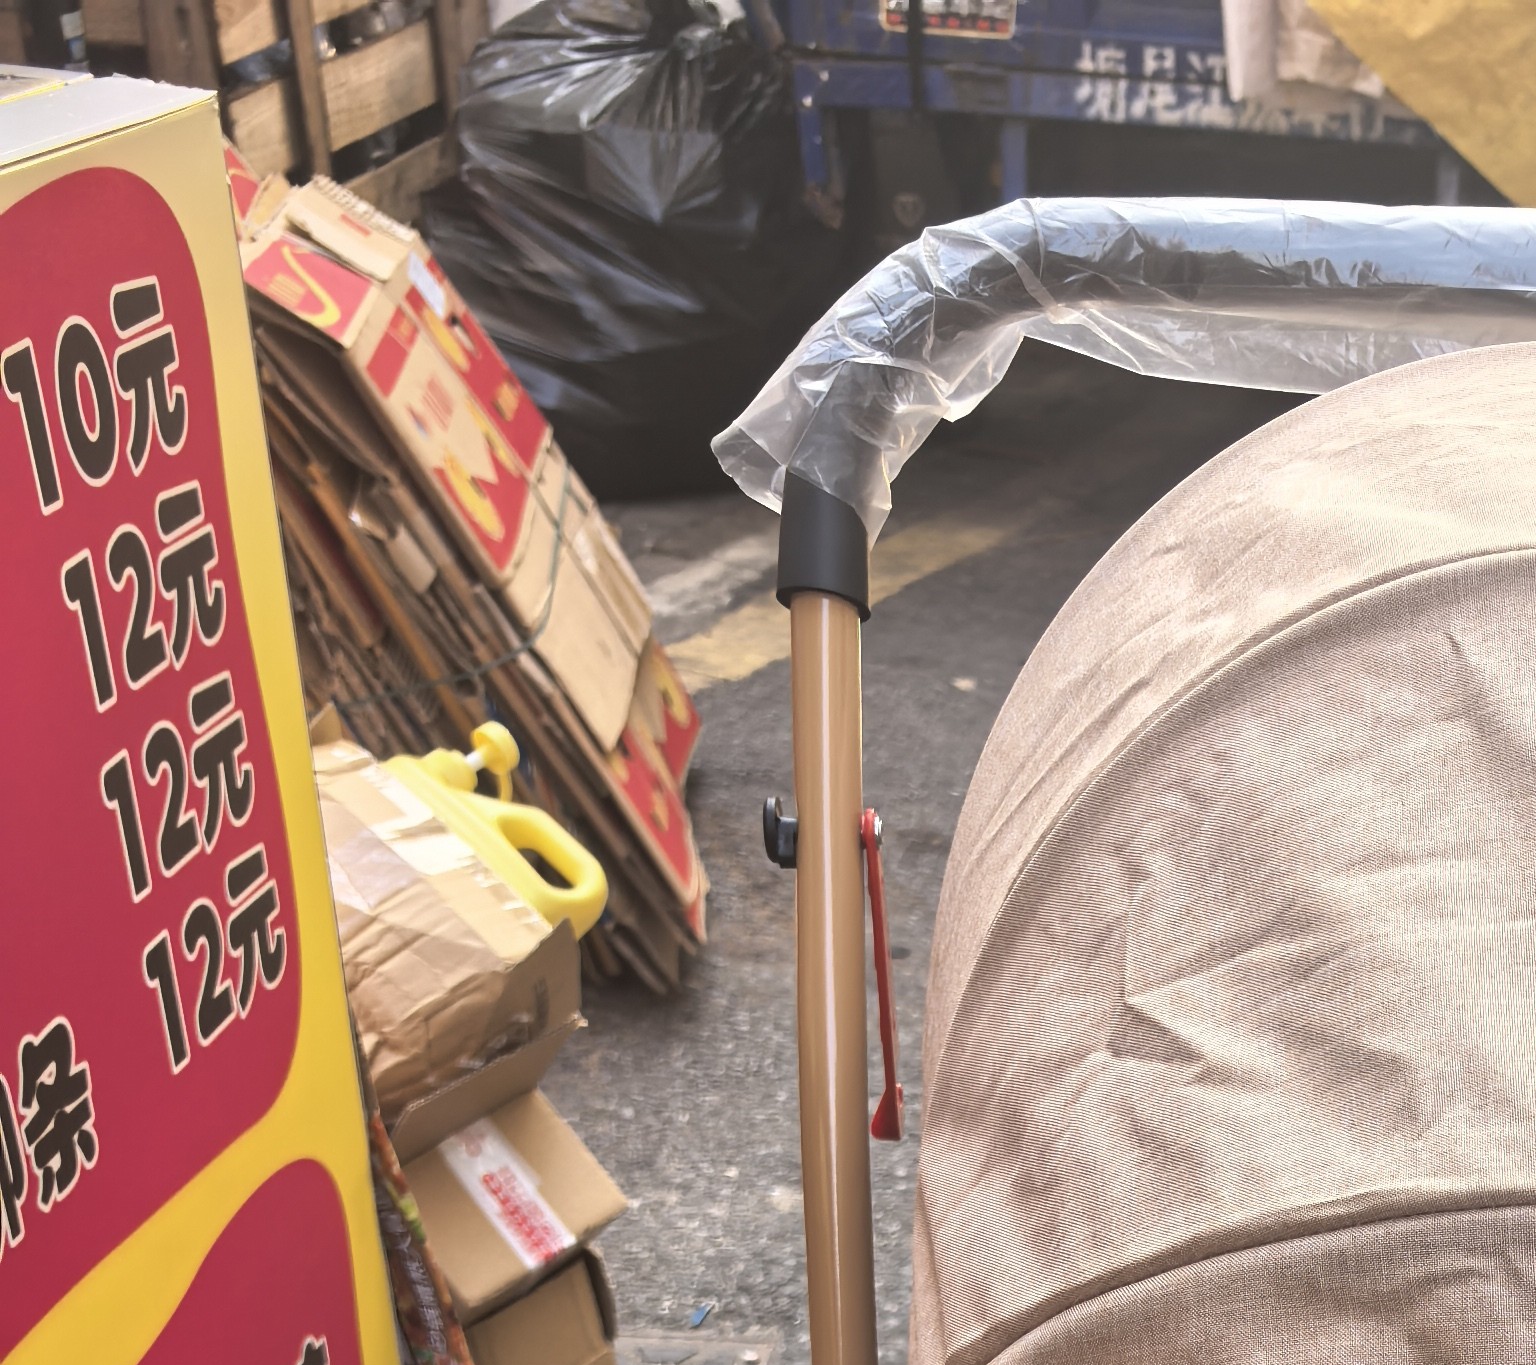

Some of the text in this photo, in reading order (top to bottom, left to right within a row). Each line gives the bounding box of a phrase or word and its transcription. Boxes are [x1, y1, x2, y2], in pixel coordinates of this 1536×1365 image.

[1, 276, 188, 515] 10元
[61, 481, 226, 712] 12元
[101, 671, 255, 903] 12元
[143, 844, 287, 1074] 12元
